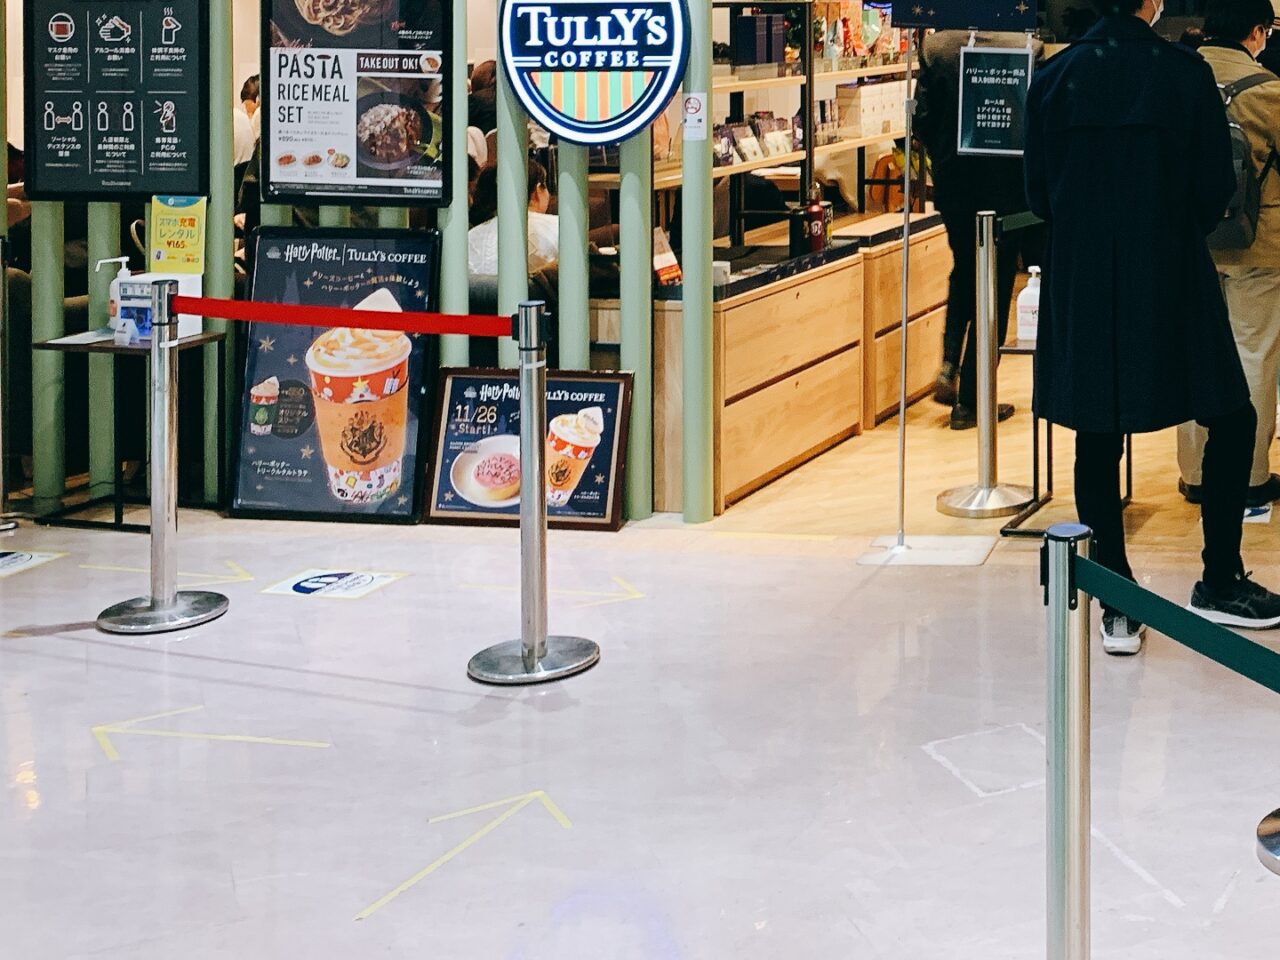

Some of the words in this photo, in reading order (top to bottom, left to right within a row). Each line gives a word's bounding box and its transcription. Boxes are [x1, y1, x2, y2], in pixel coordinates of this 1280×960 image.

[517, 6, 668, 46] TULLY'S
[278, 54, 343, 80] PASTA
[359, 57, 383, 69] TAKE
[383, 57, 399, 70] OUT
[402, 58, 418, 70] OK!
[544, 51, 639, 67] COFFEE
[278, 83, 309, 101] RICE
[312, 84, 349, 103] MEAL
[278, 106, 304, 124] SET
[160, 229, 196, 239] レンタル
[284, 243, 311, 263] Harry
[310, 242, 338, 263] Potter
[347, 248, 386, 262] TULLY'S
[387, 253, 427, 264] COFFEE
[480, 384, 503, 401] Harry
[570, 392, 606, 403] COFFEE
[455, 404, 497, 424] 11/26
